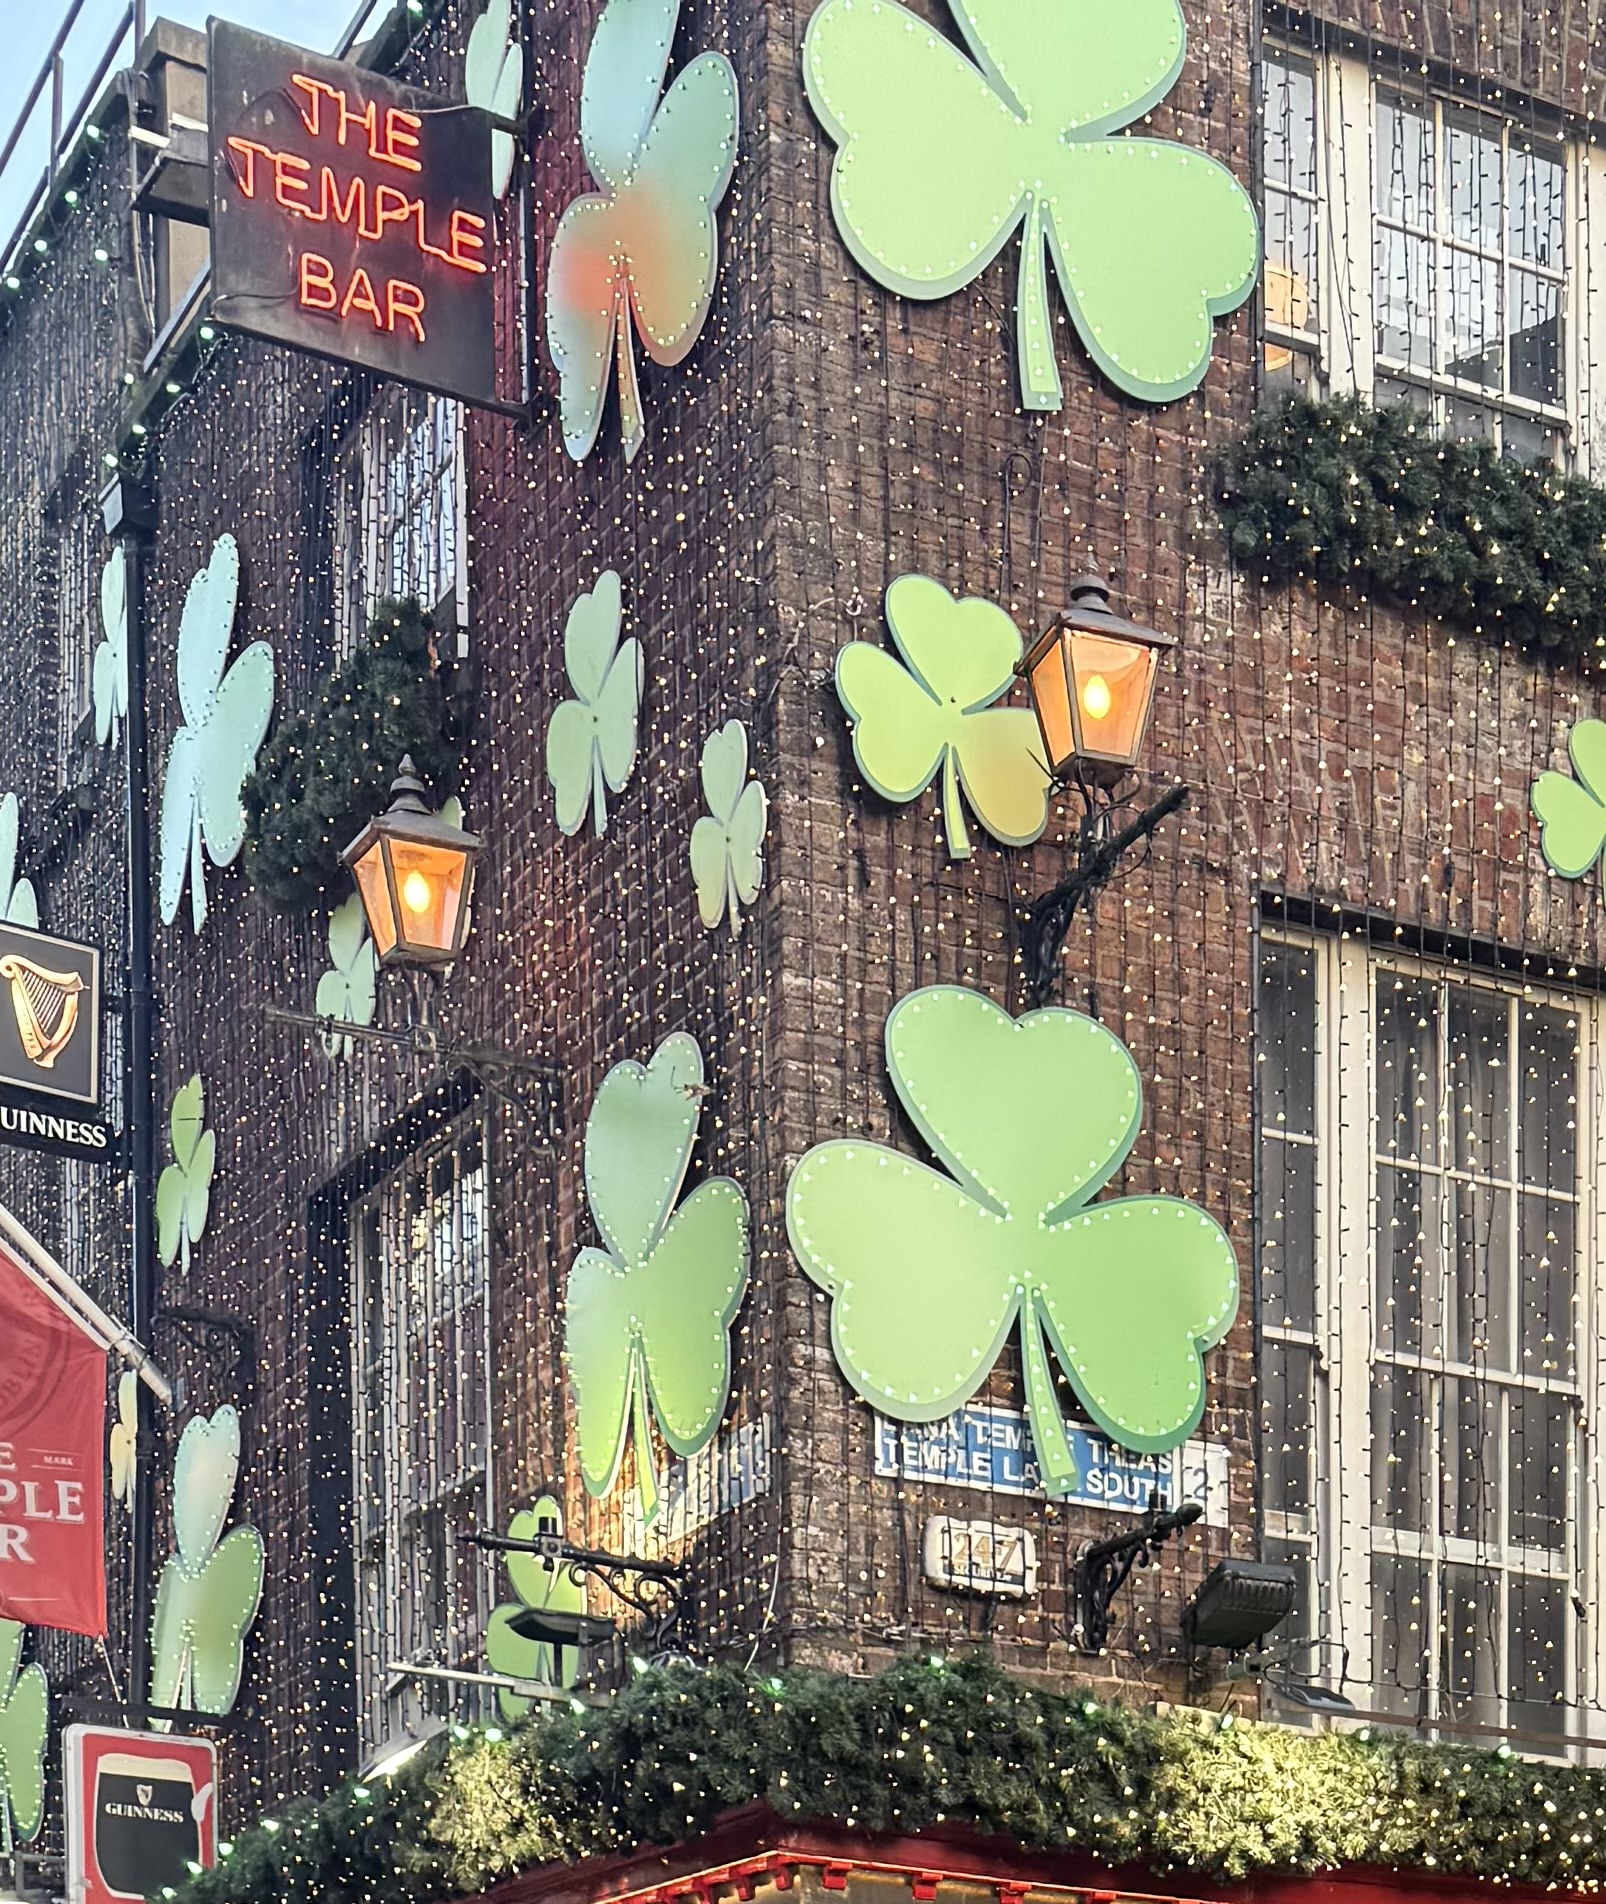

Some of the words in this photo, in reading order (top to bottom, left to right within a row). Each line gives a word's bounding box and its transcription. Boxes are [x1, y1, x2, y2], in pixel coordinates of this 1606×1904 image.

[292, 74, 422, 171] THE
[227, 136, 487, 273] TEMPLE
[299, 252, 426, 342] BAR
[0, 1105, 107, 1148] UINNESS
[0, 1480, 84, 1524] PLE
[882, 1436, 992, 1479] TEMPLE
[1003, 1455, 1042, 1485] LA
[1085, 1466, 1174, 1509] SOUTH
[105, 1802, 184, 1824] GUINNESS
